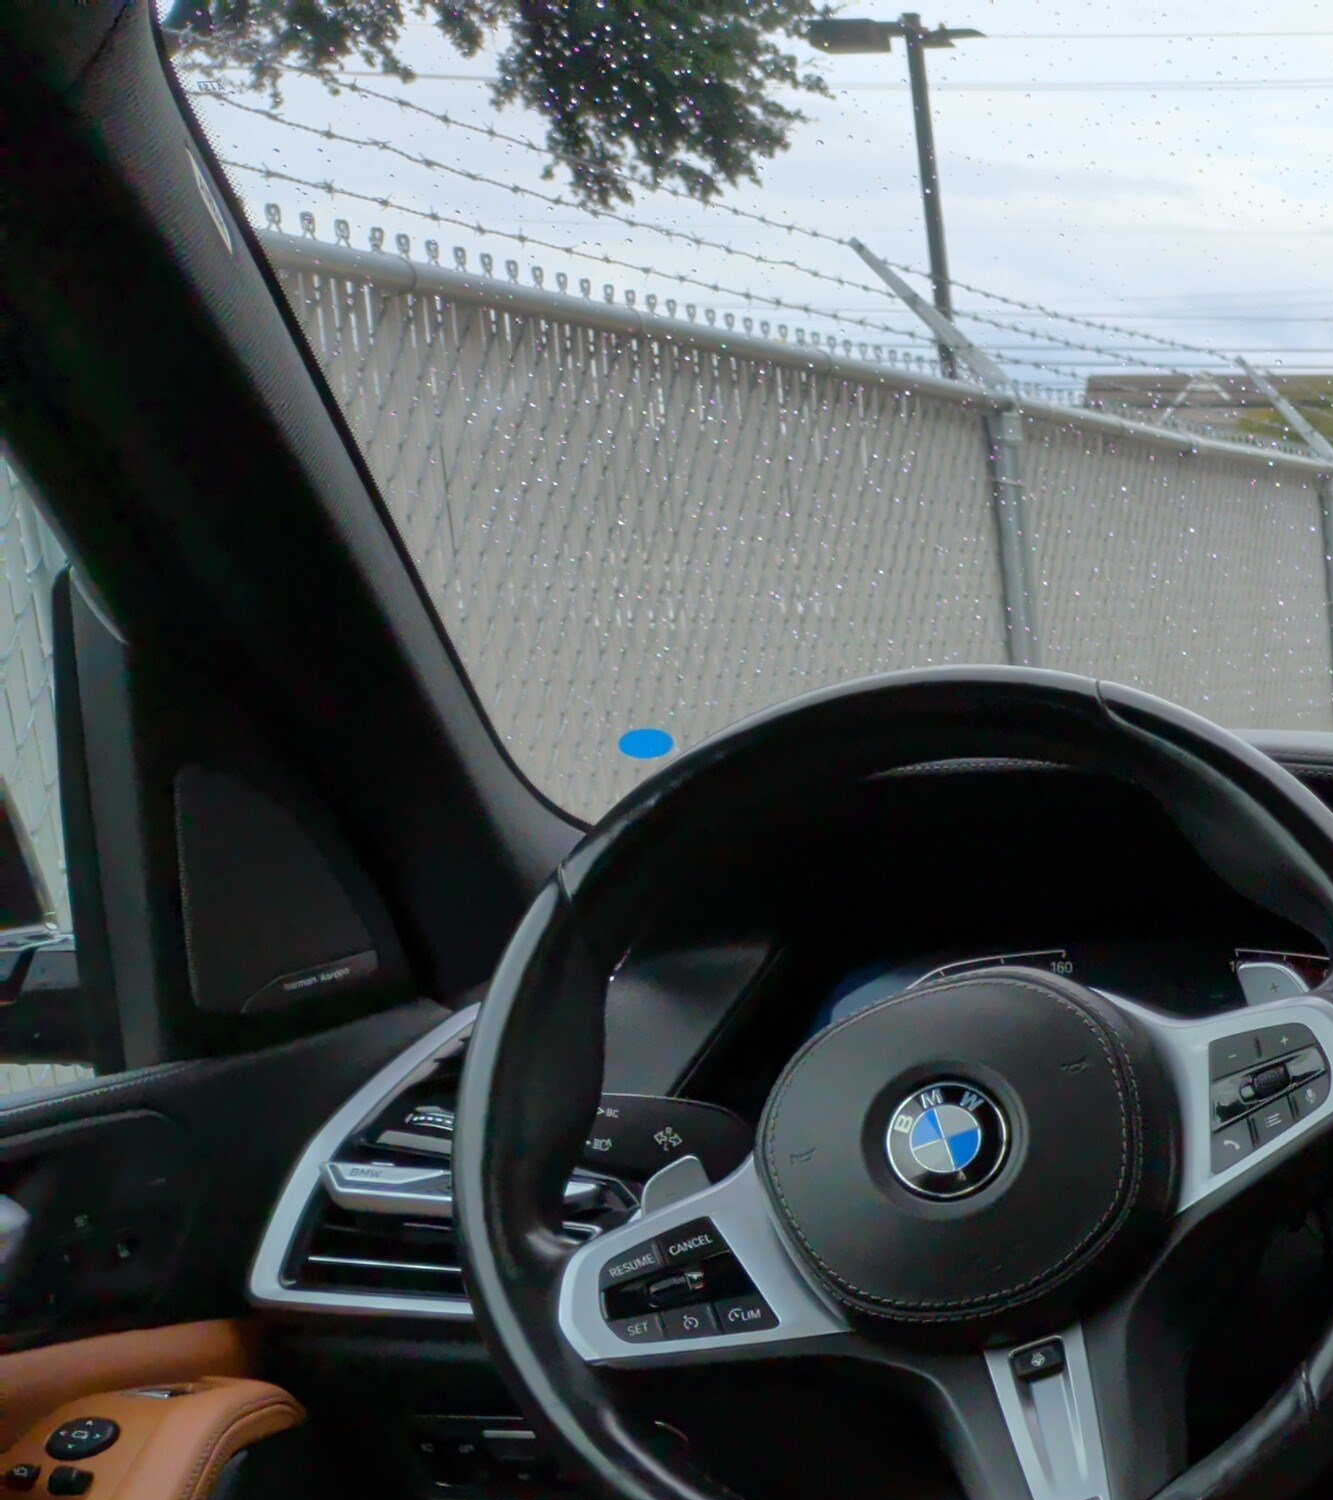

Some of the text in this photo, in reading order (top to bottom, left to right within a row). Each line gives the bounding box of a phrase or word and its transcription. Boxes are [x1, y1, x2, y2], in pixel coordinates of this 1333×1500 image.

[1050, 960, 1073, 975] 160
[893, 1088, 985, 1134] BMW
[348, 1167, 383, 1179] BMW
[668, 1233, 714, 1256] CANCEL
[608, 1253, 655, 1278] RESUME
[741, 1309, 762, 1321] LIM
[627, 1321, 648, 1337] SET
